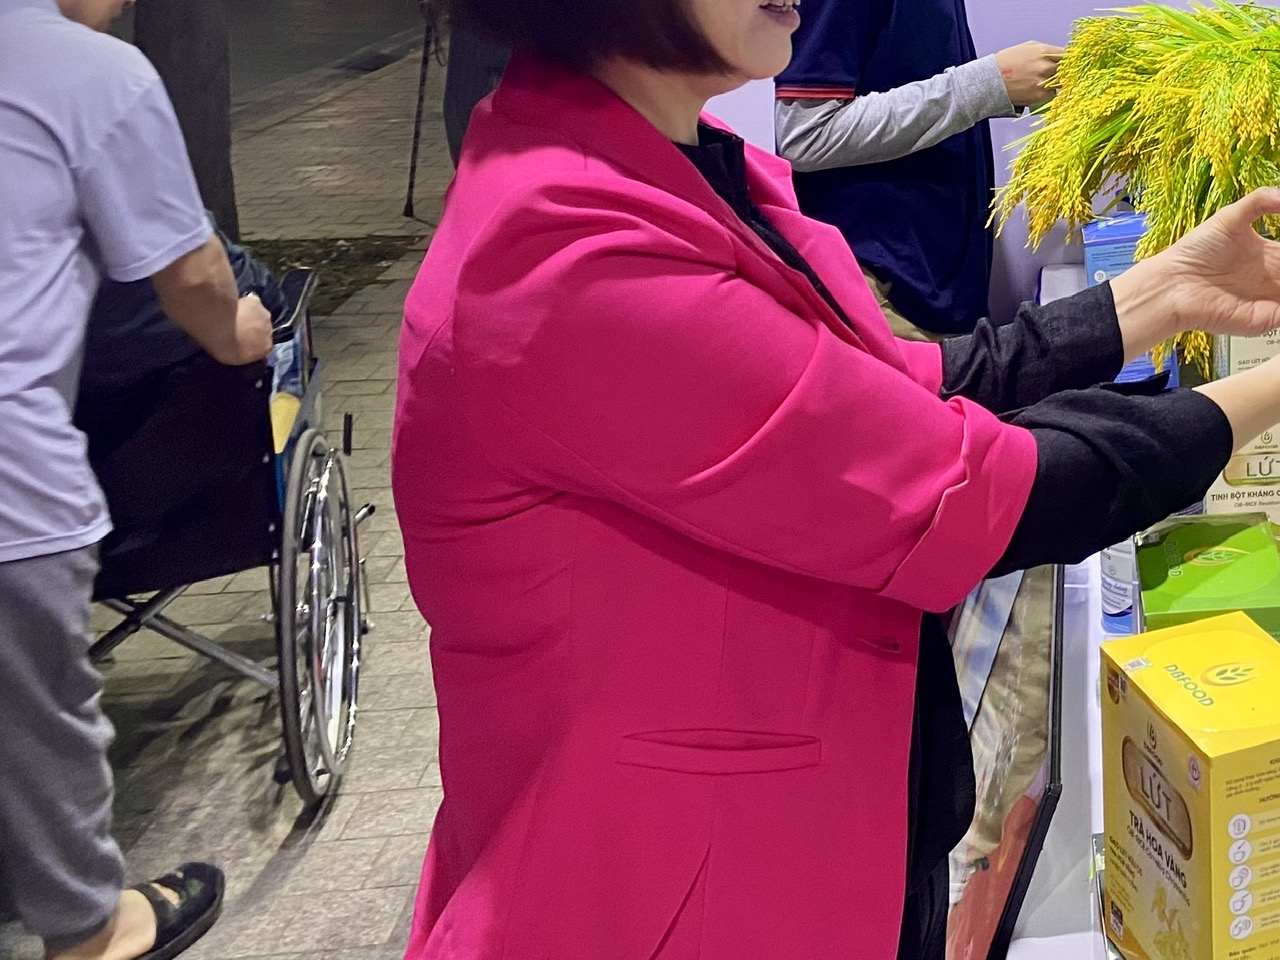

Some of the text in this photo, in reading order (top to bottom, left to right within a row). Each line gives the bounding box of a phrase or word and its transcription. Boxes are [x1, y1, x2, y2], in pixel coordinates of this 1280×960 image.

[1230, 491, 1245, 501] BỘT
[1247, 489, 1275, 498] KHÁNG
[1163, 664, 1215, 707] DBFOOD
[1140, 766, 1172, 821] LỨT
[1129, 809, 1187, 889] TRÀ HOA VÀNG
